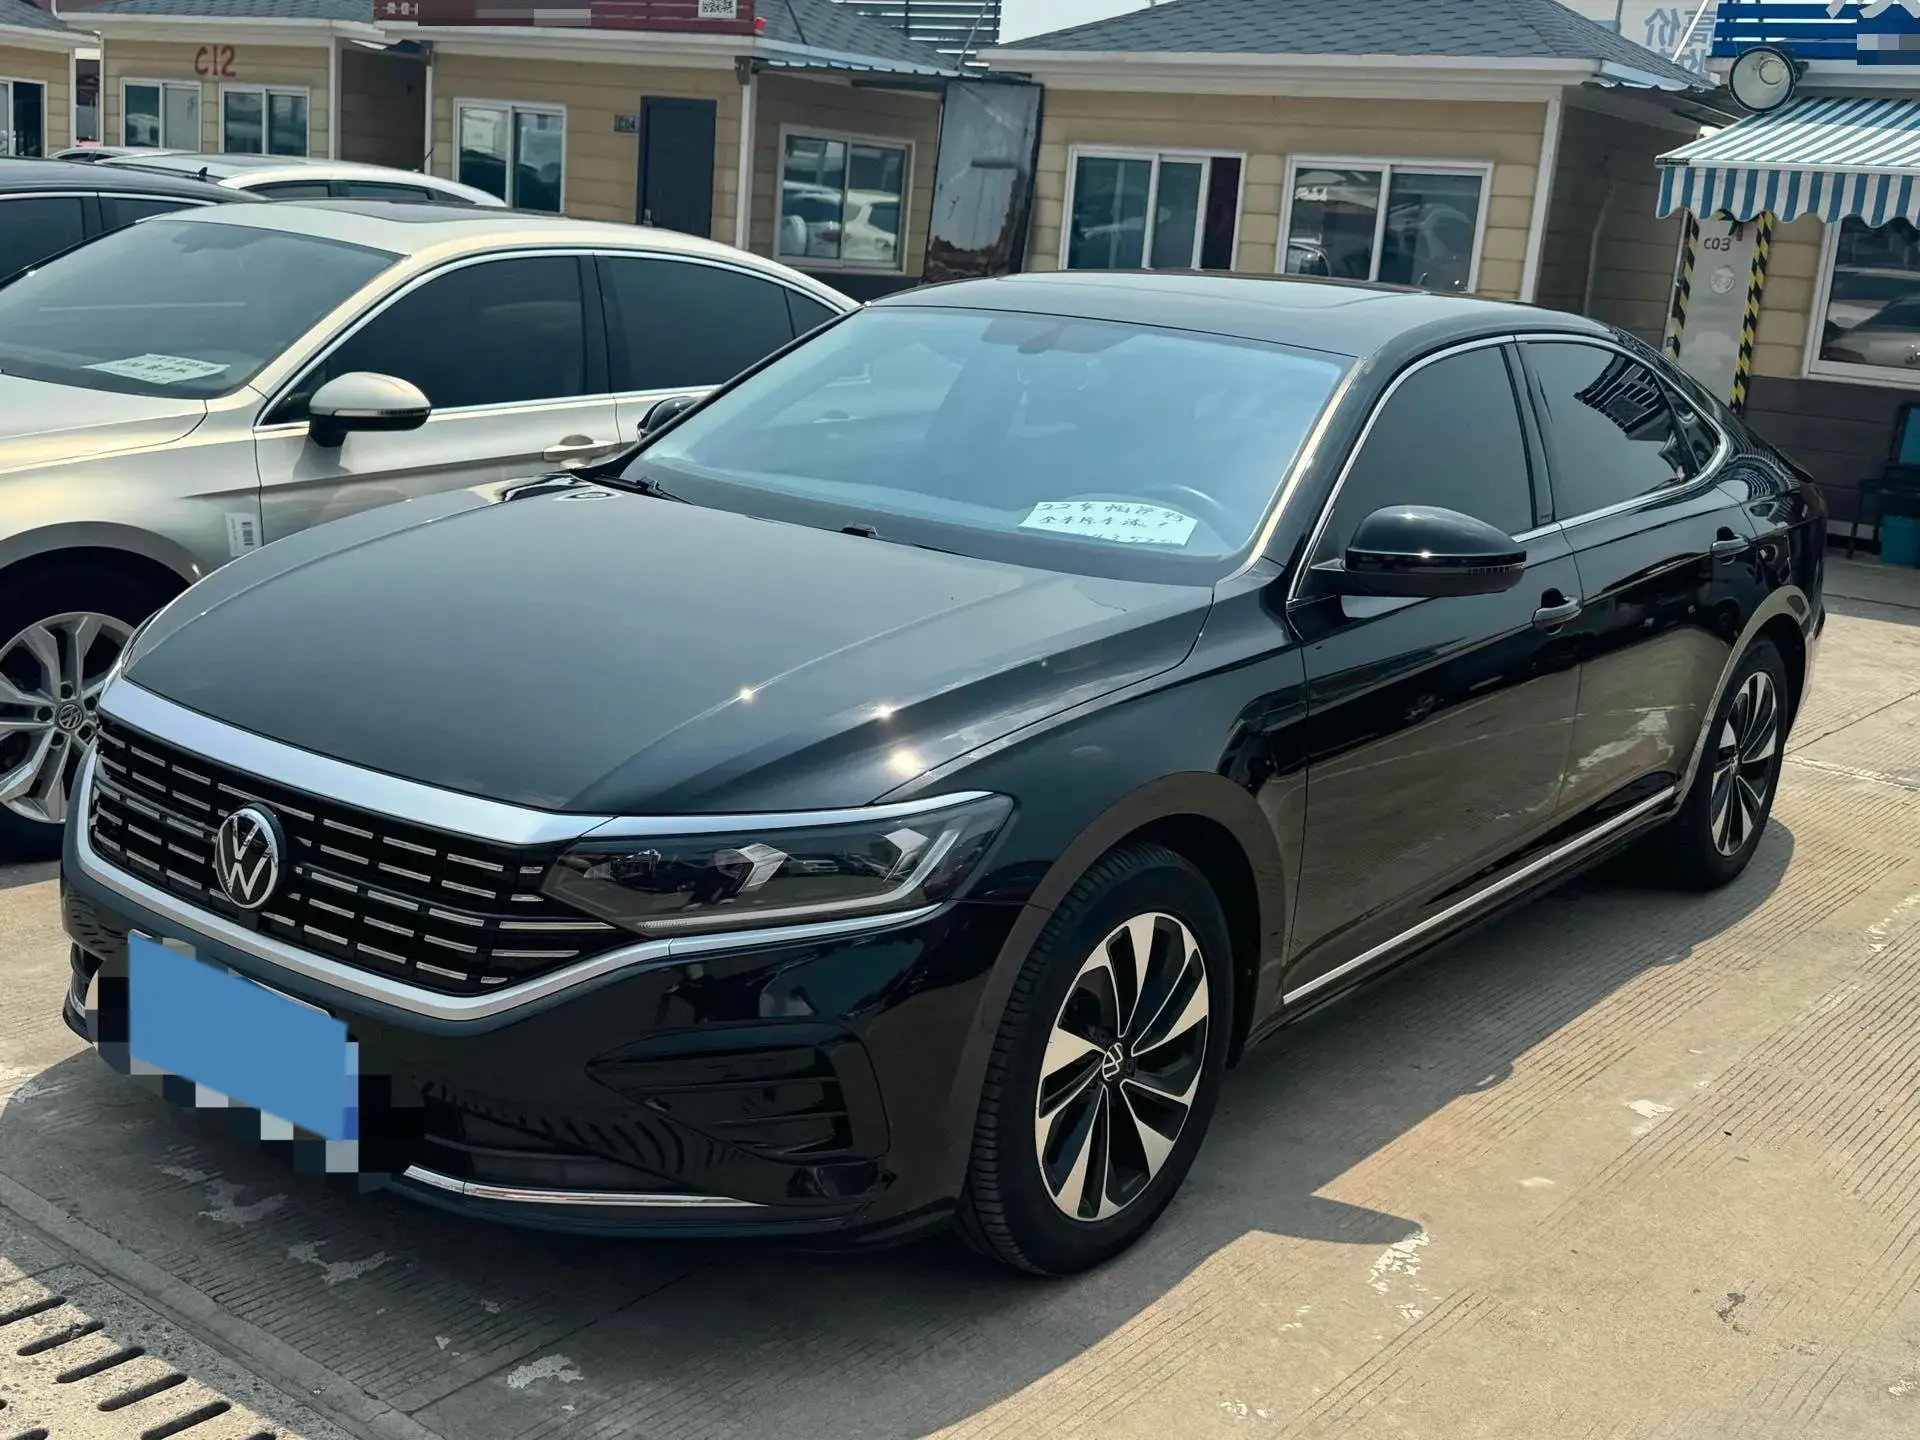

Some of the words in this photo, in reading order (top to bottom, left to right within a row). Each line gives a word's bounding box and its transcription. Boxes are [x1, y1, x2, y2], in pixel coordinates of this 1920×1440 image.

[195, 44, 236, 77] C12
[1703, 236, 1731, 252] C03
[215, 809, 278, 907] VW
